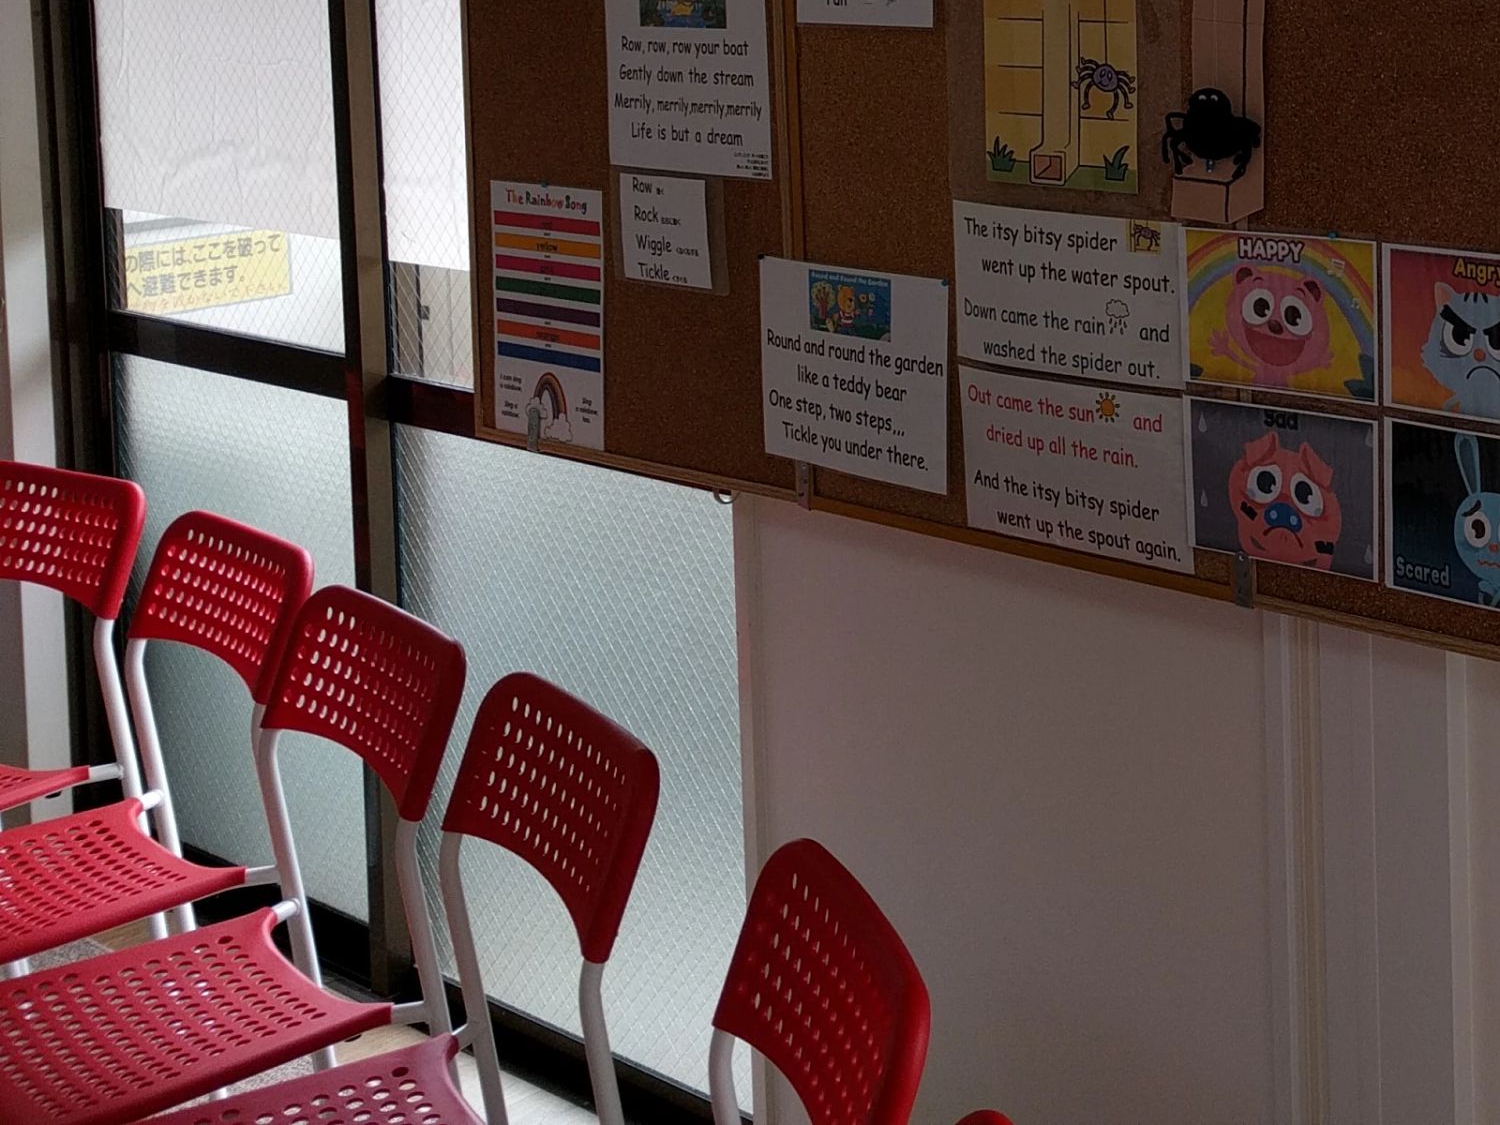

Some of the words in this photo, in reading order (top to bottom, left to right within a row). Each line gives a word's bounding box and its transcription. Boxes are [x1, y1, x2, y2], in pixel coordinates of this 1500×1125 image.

[622, 35, 644, 54] Row,
[648, 41, 669, 55] row,
[672, 42, 692, 54] row
[694, 43, 720, 57] your
[723, 38, 749, 55] boat
[620, 64, 652, 85] Gently
[657, 65, 683, 83] down
[688, 67, 708, 84] the
[713, 70, 754, 87] stream
[632, 122, 652, 139] Life
[658, 124, 666, 140] is
[672, 125, 690, 141] but
[695, 131, 701, 143] a
[707, 128, 743, 146] dream
[632, 177, 652, 193] Row
[505, 188, 523, 205] The
[565, 195, 587, 215] Song
[634, 205, 658, 223] Rock
[636, 235, 672, 255] Wiggle
[964, 217, 988, 237] The
[993, 221, 1018, 243] itsy
[1024, 224, 1062, 248] bitsy
[1067, 231, 1117, 251] spider
[1238, 237, 1303, 262] HAPPY
[638, 262, 670, 281] Tickle
[982, 259, 1014, 275] went
[1019, 264, 1035, 281] up
[1040, 263, 1067, 281] the
[1072, 269, 1118, 287] water
[1124, 275, 1174, 293] spout.
[964, 297, 996, 321] Down
[1001, 309, 1038, 327] came
[1042, 310, 1070, 331] the
[1075, 317, 1105, 335] rain
[1140, 325, 1169, 342] and
[768, 329, 801, 351] Round
[804, 339, 824, 356] and
[828, 345, 865, 363] round
[868, 348, 891, 368] the
[895, 355, 943, 377] garden
[984, 342, 1035, 361] washed
[1040, 347, 1067, 366] the
[1072, 352, 1122, 373] spider
[1128, 361, 1160, 379] out.
[798, 364, 819, 385] like
[822, 375, 829, 387] a
[833, 374, 871, 399] teddy
[876, 379, 907, 401] bear
[769, 389, 792, 409] One
[796, 397, 826, 420] step,
[829, 403, 852, 423] two
[856, 411, 904, 436] steps...
[1264, 409, 1298, 430] Sad
[782, 421, 818, 445] Tickle
[821, 435, 841, 454] you
[845, 439, 882, 459] under
[886, 445, 928, 471] there.
[1394, 555, 1450, 587] Scared
